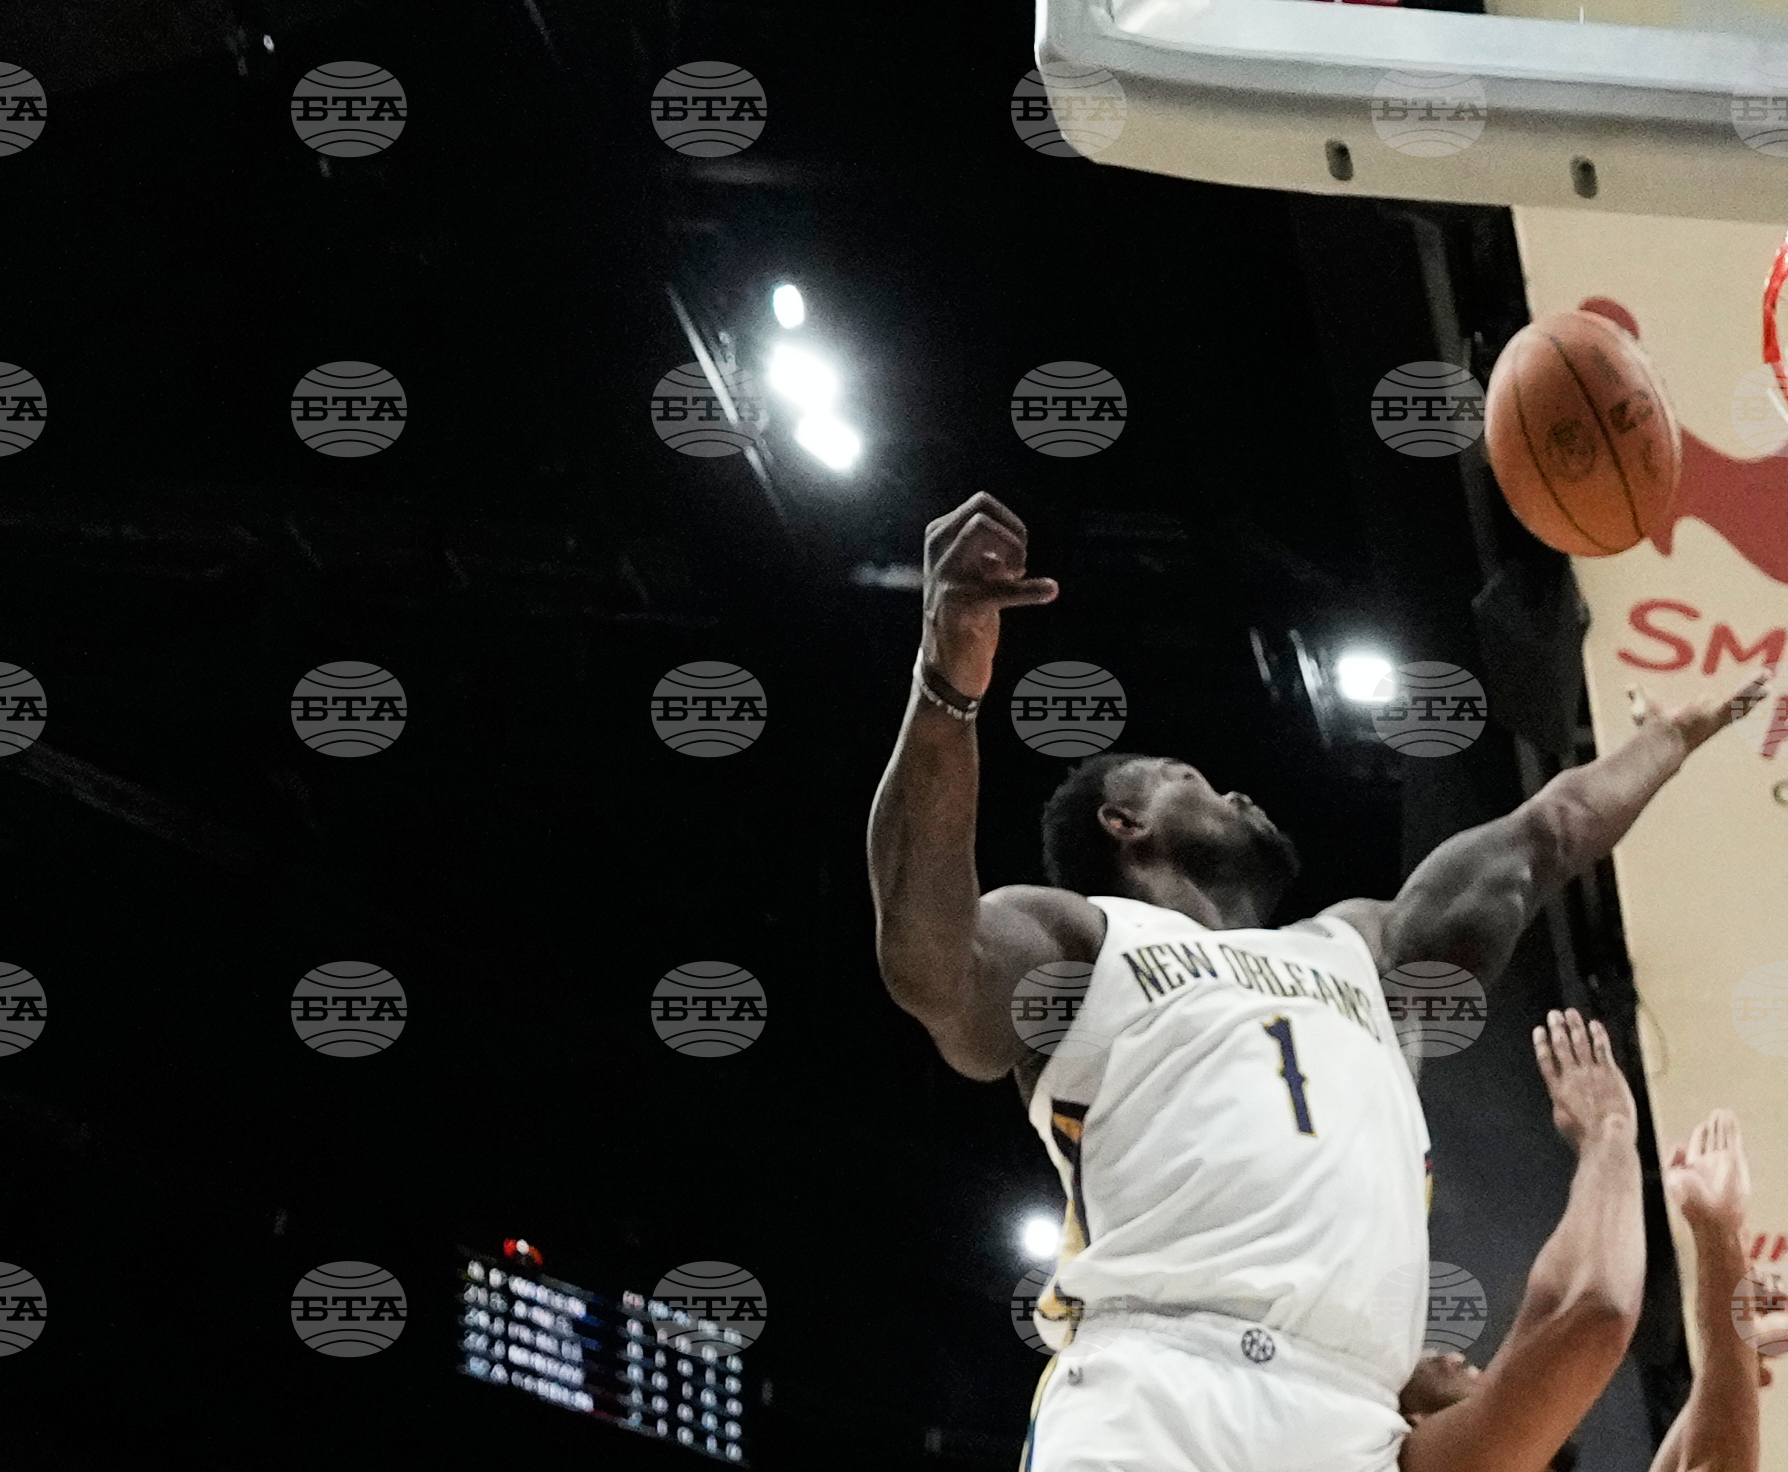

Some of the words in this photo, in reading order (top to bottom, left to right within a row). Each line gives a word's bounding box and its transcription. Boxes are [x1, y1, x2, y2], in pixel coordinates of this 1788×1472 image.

[1120, 942, 1218, 1004] NEW
[1219, 944, 1382, 1043] ORLEANS
[1261, 1015, 1319, 1139] 1
